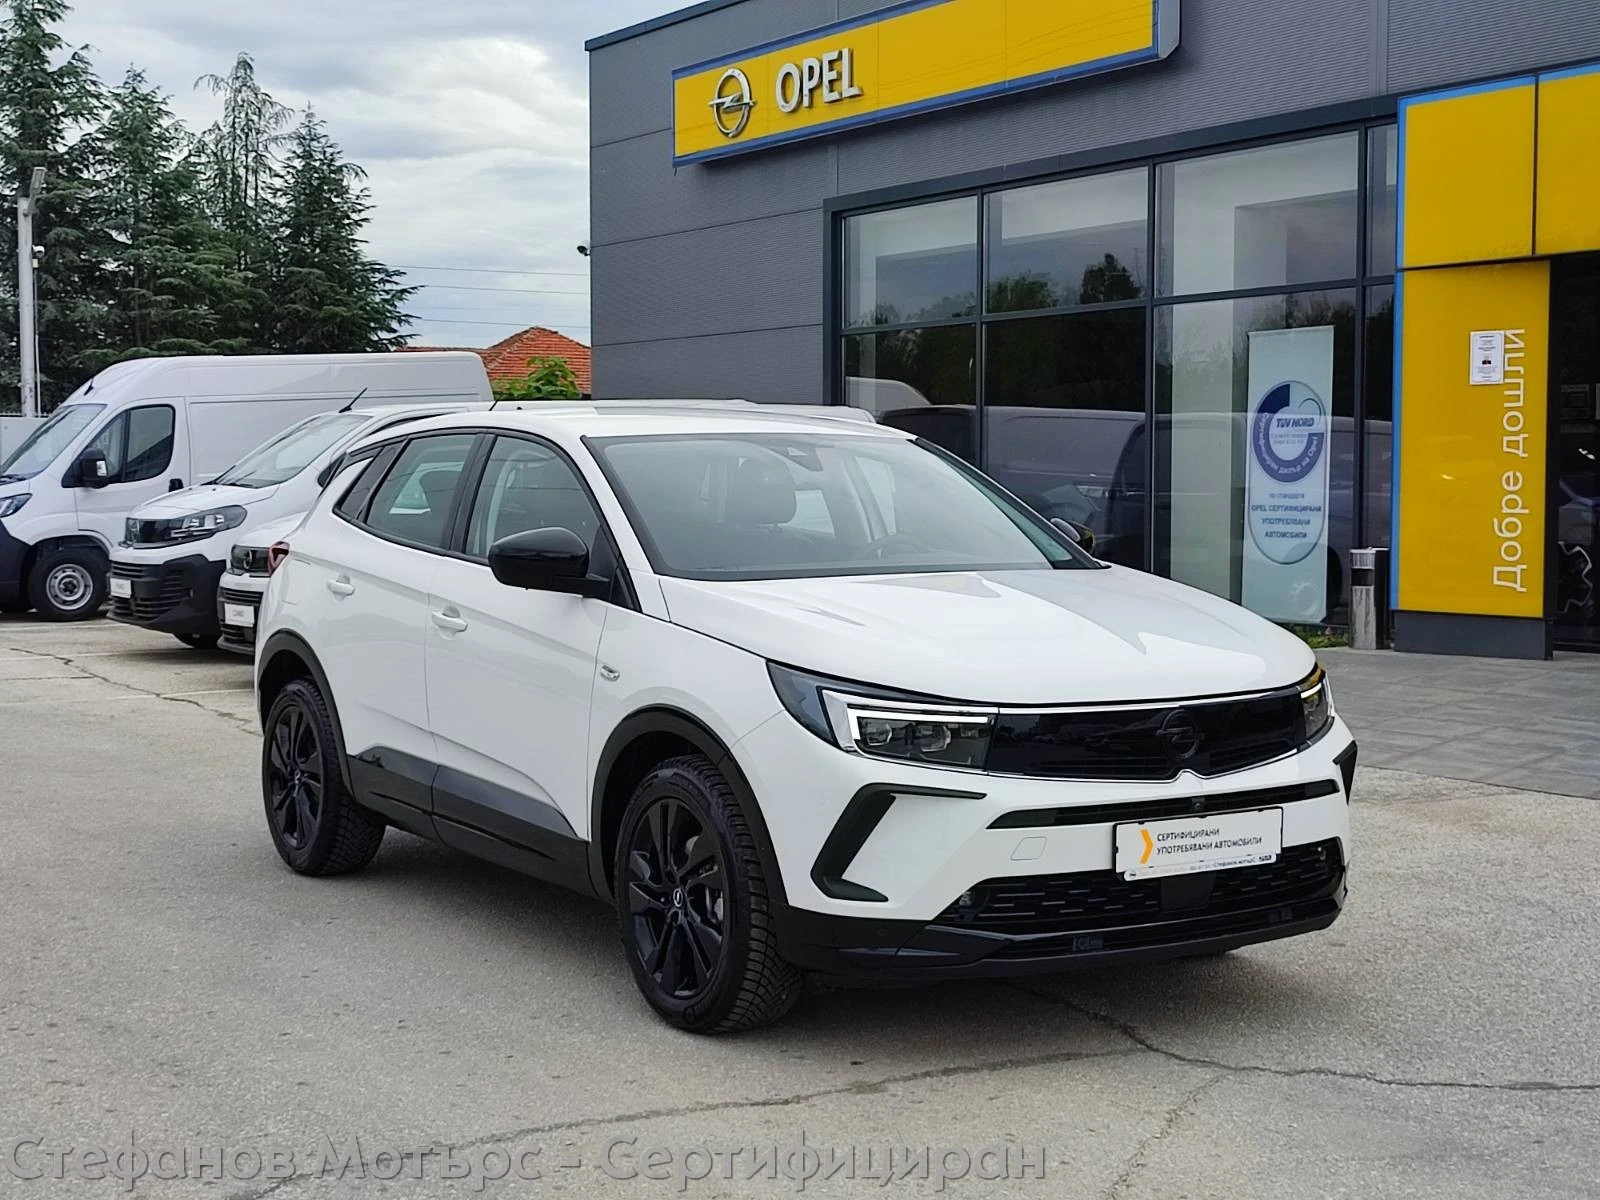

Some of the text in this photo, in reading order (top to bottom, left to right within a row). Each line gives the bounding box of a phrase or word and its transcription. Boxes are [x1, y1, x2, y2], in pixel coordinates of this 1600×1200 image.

[775, 47, 864, 113] OPEL
[1493, 329, 1529, 592] Добре дошли
[1156, 828, 1220, 842] СЕРТИФИЦИРАНИ
[1156, 836, 1263, 856] УПОТРЕБЯВАНИ АВТОМОБИЛИ
